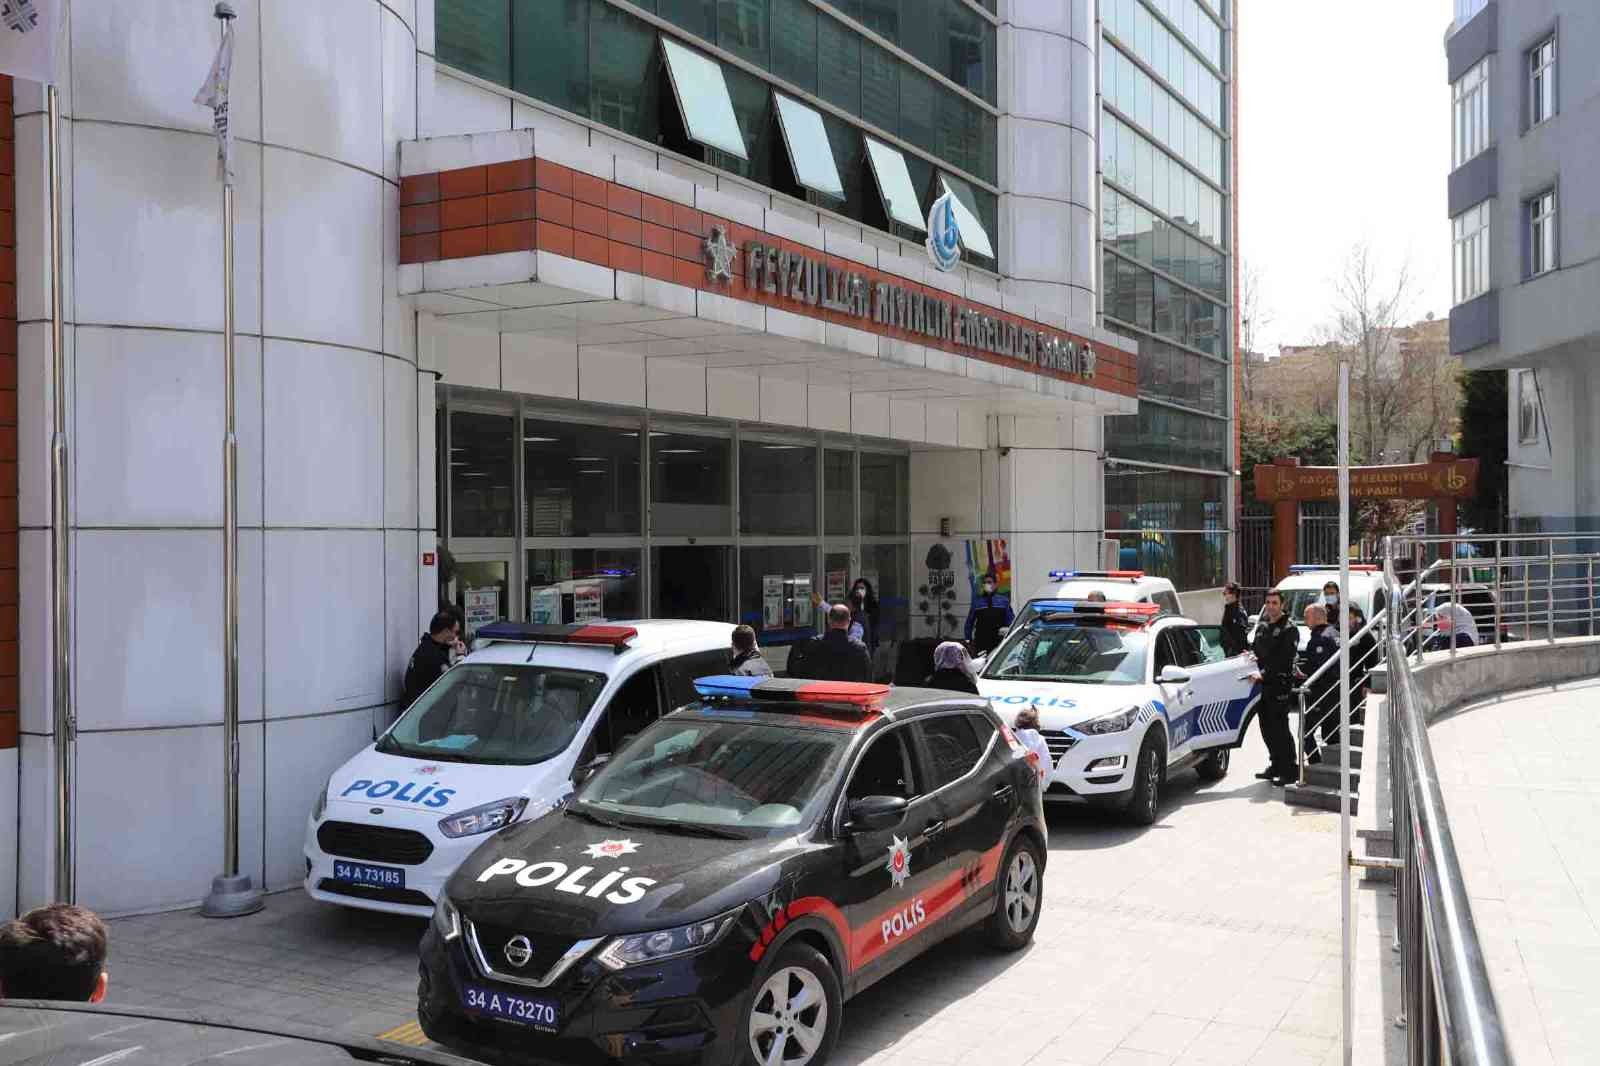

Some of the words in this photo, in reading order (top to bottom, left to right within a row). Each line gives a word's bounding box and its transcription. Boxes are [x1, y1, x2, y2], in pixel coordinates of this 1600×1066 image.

[746, 241, 871, 319] FEYZULLAH
[340, 780, 457, 808] POLİS
[336, 865, 351, 879] 34
[353, 867, 362, 880] A
[365, 868, 400, 884] 73185
[475, 857, 657, 905] POLİS
[881, 898, 926, 944] POLİS
[467, 989, 486, 1009] 34
[489, 994, 502, 1012] A
[507, 997, 555, 1023] 73270
